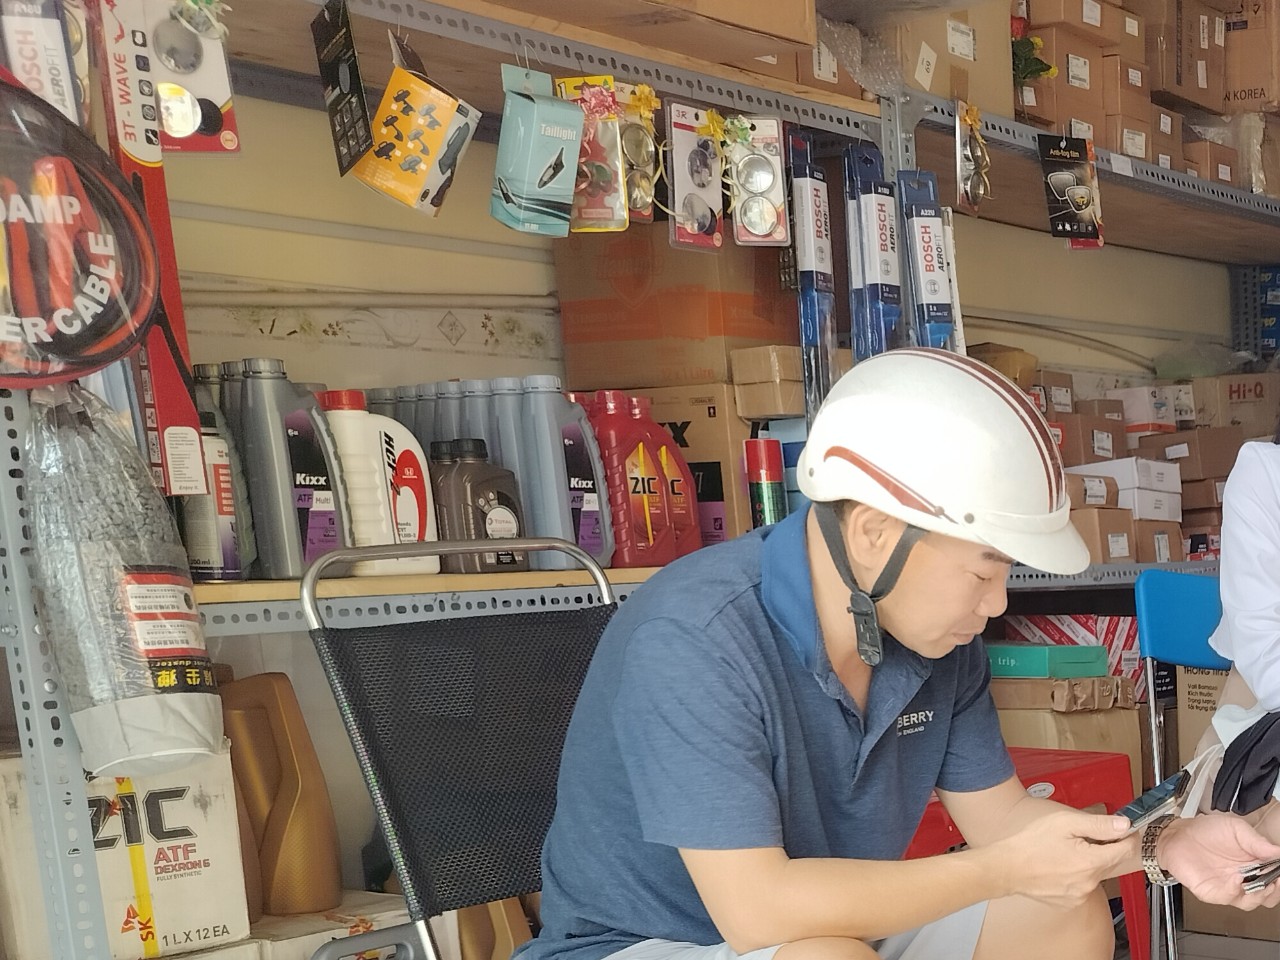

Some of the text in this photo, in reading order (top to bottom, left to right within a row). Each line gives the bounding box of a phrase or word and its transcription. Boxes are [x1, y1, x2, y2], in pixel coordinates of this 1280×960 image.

[15, 29, 46, 96] OSCH
[113, 52, 132, 106] WAVE
[1233, 88, 1266, 101] KOREA
[675, 109, 688, 120] 3R
[540, 123, 577, 141] Taillight
[813, 187, 824, 240] BOSCH
[877, 202, 889, 253] BOSCH
[920, 224, 936, 273] BOSCH
[934, 233, 945, 272] AEROFIT
[53, 231, 116, 336] CABLE
[1229, 382, 1265, 401] Hi-Q
[295, 472, 328, 486] Kixx
[570, 477, 594, 489] Kixx
[629, 477, 658, 495] ZIC
[297, 493, 313, 503] ATF
[315, 496, 331, 505] Multi
[572, 495, 584, 503] ATF
[897, 710, 934, 728] BERRY
[86, 785, 198, 852] ZIC
[154, 843, 197, 865] ATF
[154, 858, 211, 875] DEXRON 6
[156, 870, 202, 882] FULLY SYNTHETIC
[137, 917, 155, 942] SK
[195, 927, 211, 941] 12
[213, 925, 231, 938] EA
